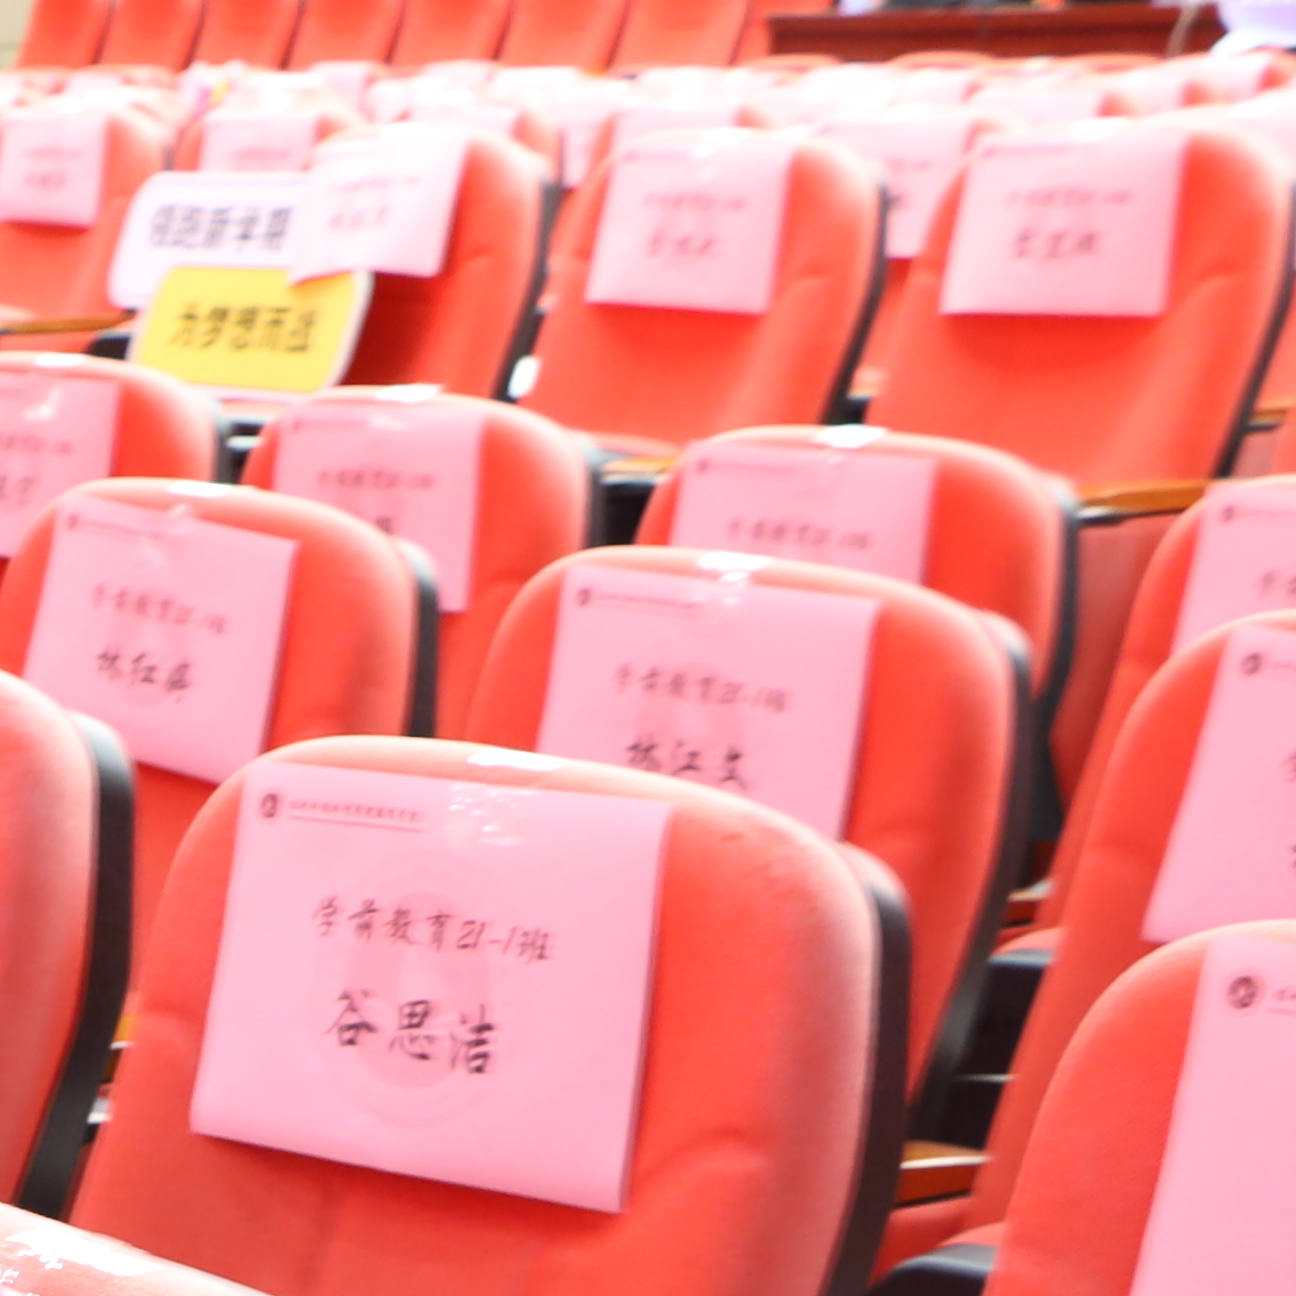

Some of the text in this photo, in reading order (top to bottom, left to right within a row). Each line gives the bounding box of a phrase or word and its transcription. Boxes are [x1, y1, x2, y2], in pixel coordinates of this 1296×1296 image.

[312, 894, 555, 963] 学前教育21-1班
[325, 988, 499, 1075] 谷思洁
